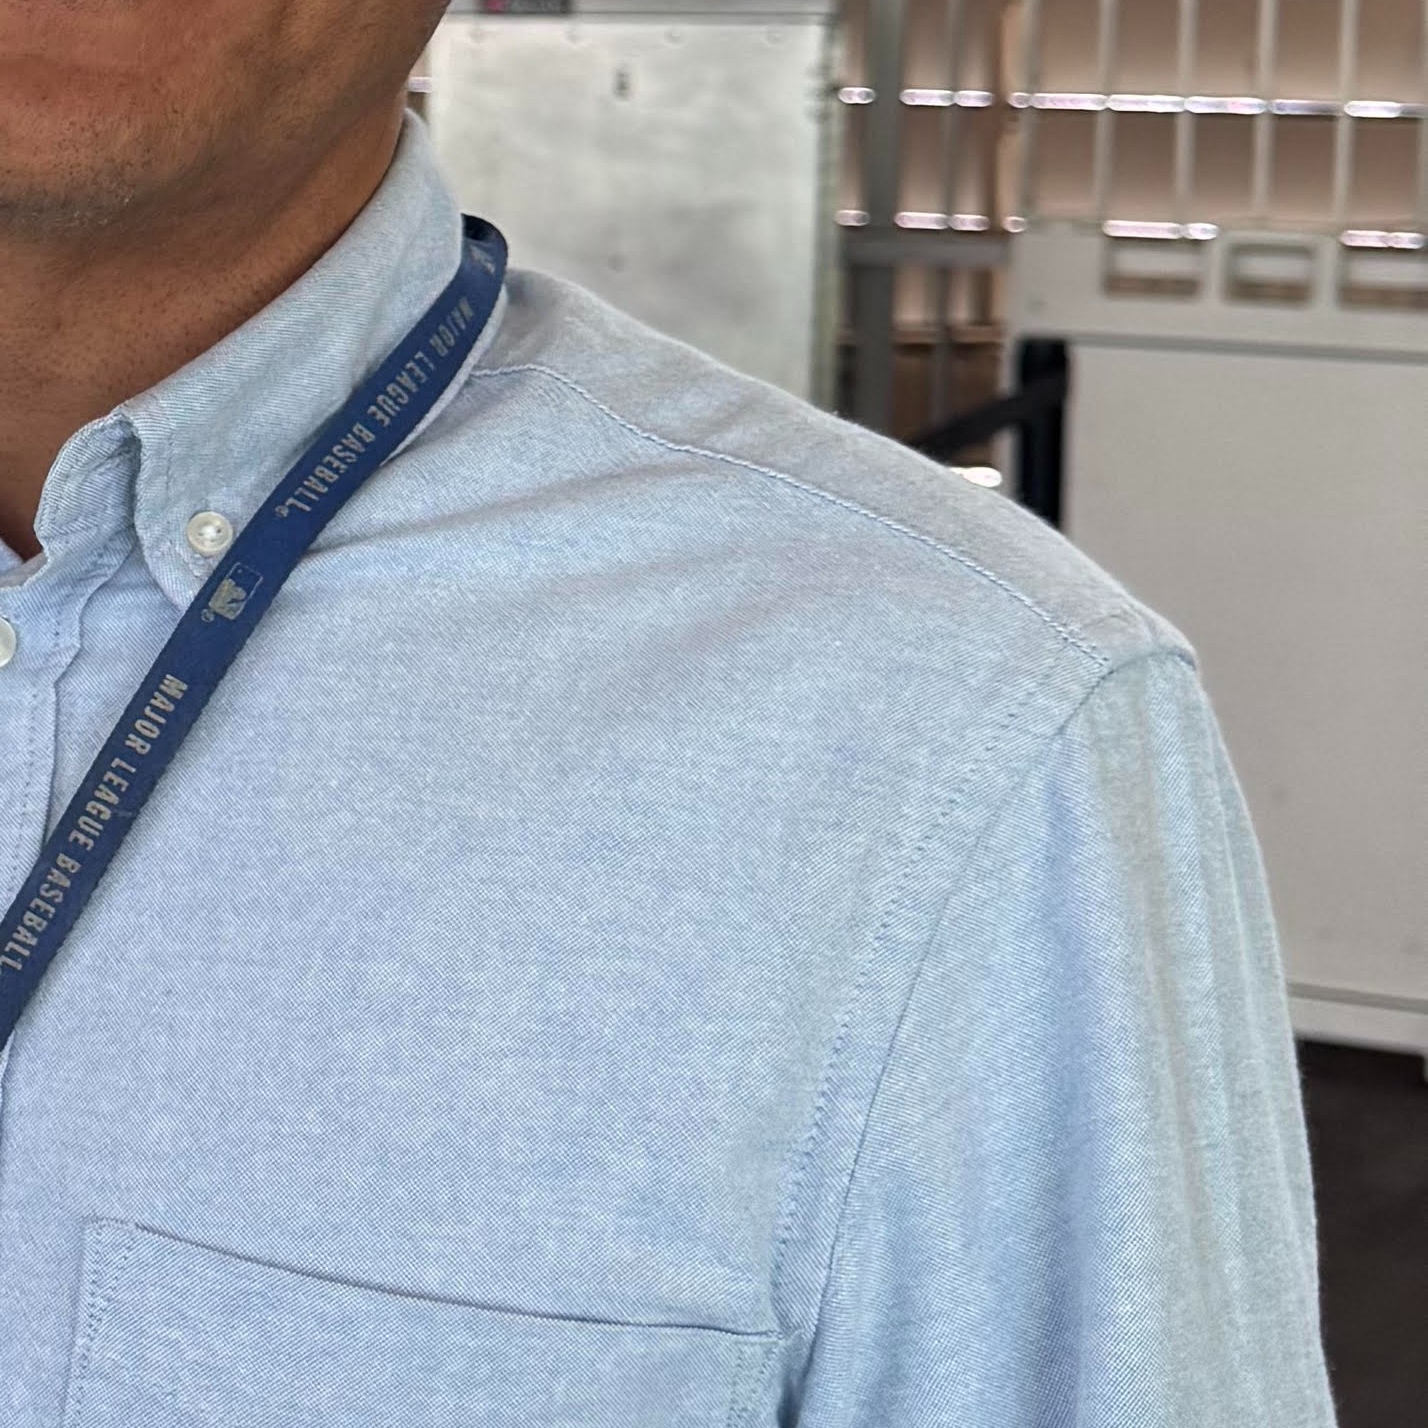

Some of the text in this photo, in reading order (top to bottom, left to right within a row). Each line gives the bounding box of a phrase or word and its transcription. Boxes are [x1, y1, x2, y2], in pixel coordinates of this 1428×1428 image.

[429, 297, 475, 357] MAJOR
[367, 351, 434, 428] LEAGUE
[124, 673, 188, 755] MAJOR
[68, 756, 137, 853] LEAGUE
